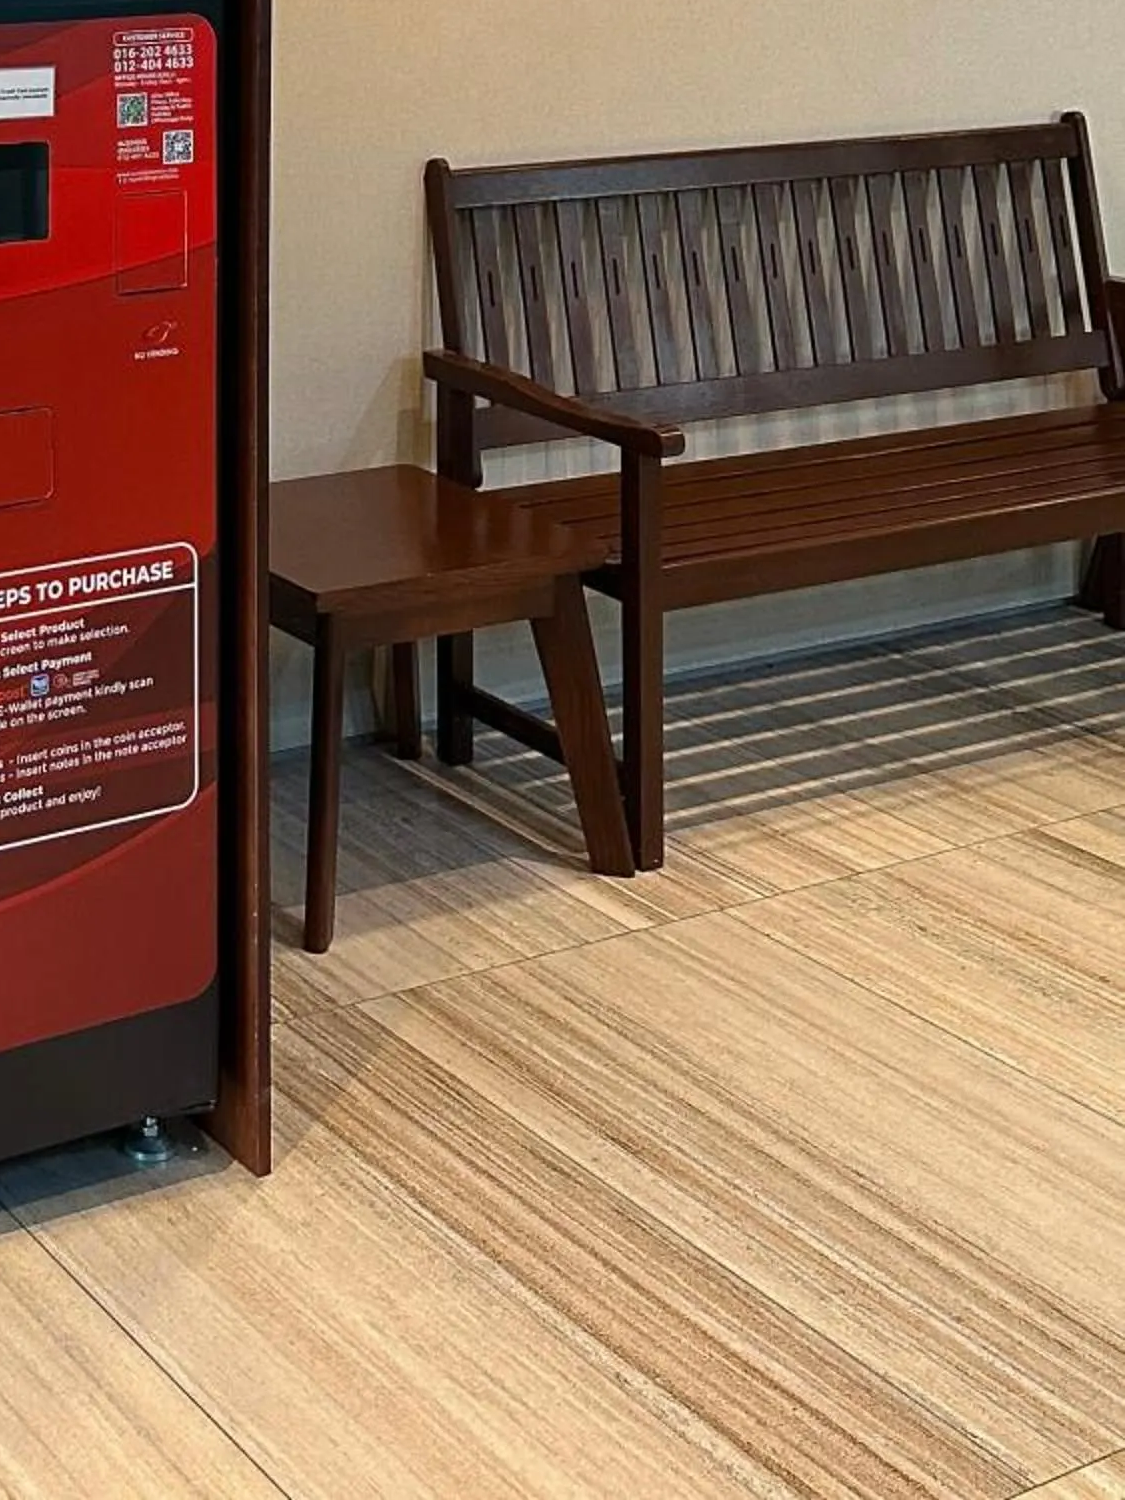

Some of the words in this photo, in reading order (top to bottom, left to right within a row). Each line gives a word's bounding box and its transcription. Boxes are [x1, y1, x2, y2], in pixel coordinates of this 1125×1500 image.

[36, 580, 64, 603] TO
[68, 560, 175, 597] PURCHASE
[1, 628, 37, 643] Select
[39, 617, 85, 639] Product
[33, 640, 45, 650] to
[47, 633, 78, 647] make
[2, 661, 39, 677] Select
[41, 651, 93, 671] Payment
[45, 687, 93, 709] payment
[94, 680, 126, 698] kindly
[129, 676, 154, 691] scan
[10, 716, 24, 728] on
[26, 710, 46, 724] the
[50, 744, 79, 758] coins
[80, 739, 91, 751] in
[93, 735, 112, 748] the
[113, 730, 136, 744] coin
[49, 758, 80, 772] notes
[82, 753, 92, 765] in
[94, 748, 112, 761] the
[114, 743, 138, 757] note
[3, 784, 44, 803] Collect
[0, 801, 44, 820] product
[45, 794, 66, 808] and
